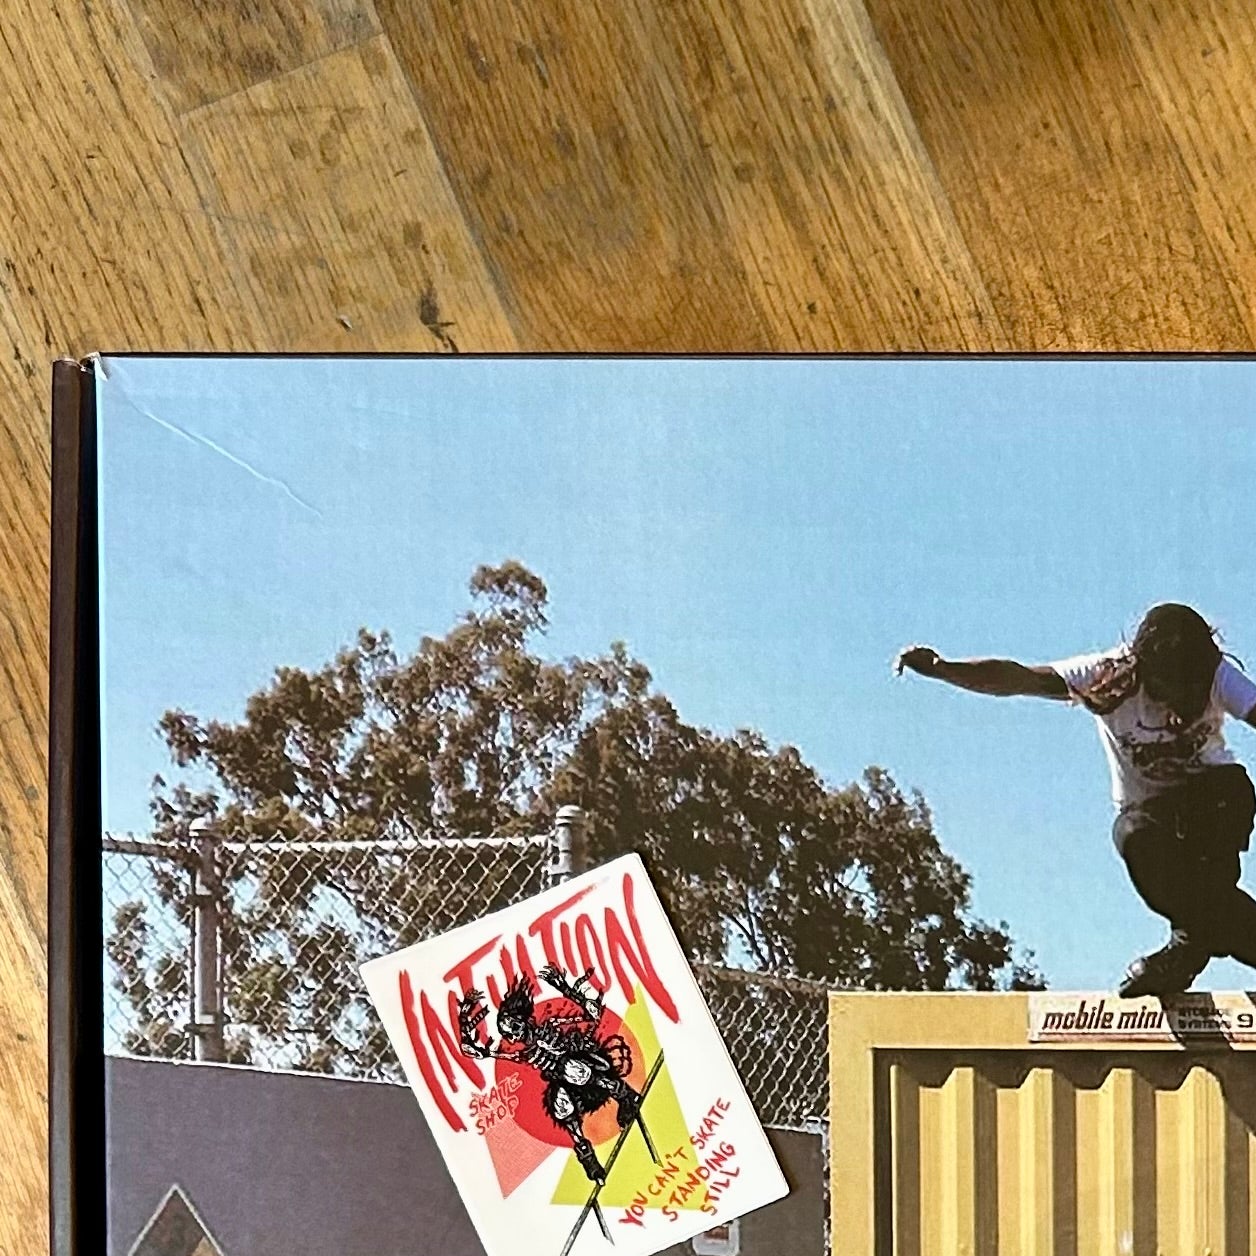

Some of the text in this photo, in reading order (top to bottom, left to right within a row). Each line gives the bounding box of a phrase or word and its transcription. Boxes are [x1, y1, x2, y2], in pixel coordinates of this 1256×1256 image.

[1042, 999, 1163, 1030] mobile mini
[469, 1071, 524, 1117] SKATE
[475, 1095, 520, 1135] SHOP
[618, 1097, 731, 1229] YOU CAN'T SKATE
[661, 1141, 736, 1222] STANDING
[700, 1166, 740, 1216] STILL
